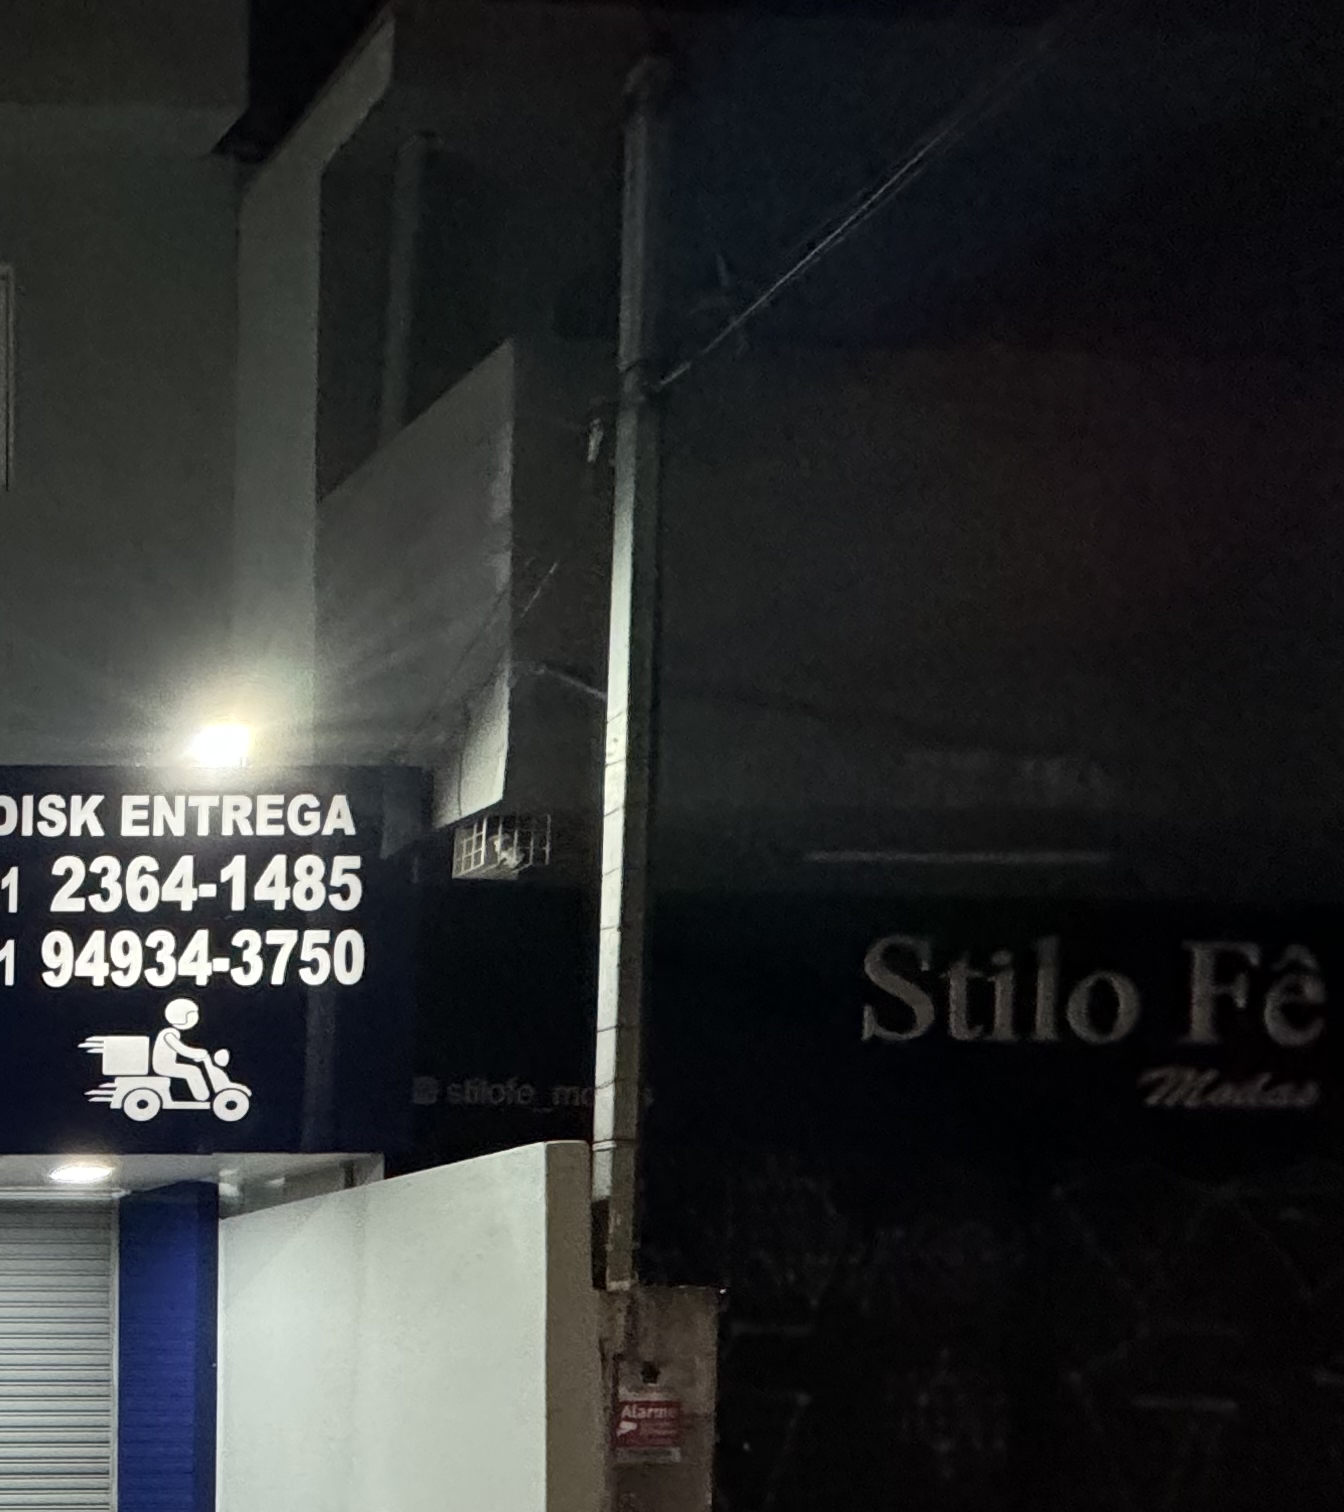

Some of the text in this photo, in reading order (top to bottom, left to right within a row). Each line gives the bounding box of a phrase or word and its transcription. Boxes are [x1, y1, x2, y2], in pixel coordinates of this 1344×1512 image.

[120, 794, 356, 836] ENTREGA
[49, 855, 363, 912] 2364-1485
[41, 929, 366, 988] 94934-3750
[861, 934, 1328, 1047] Stilo Fê
